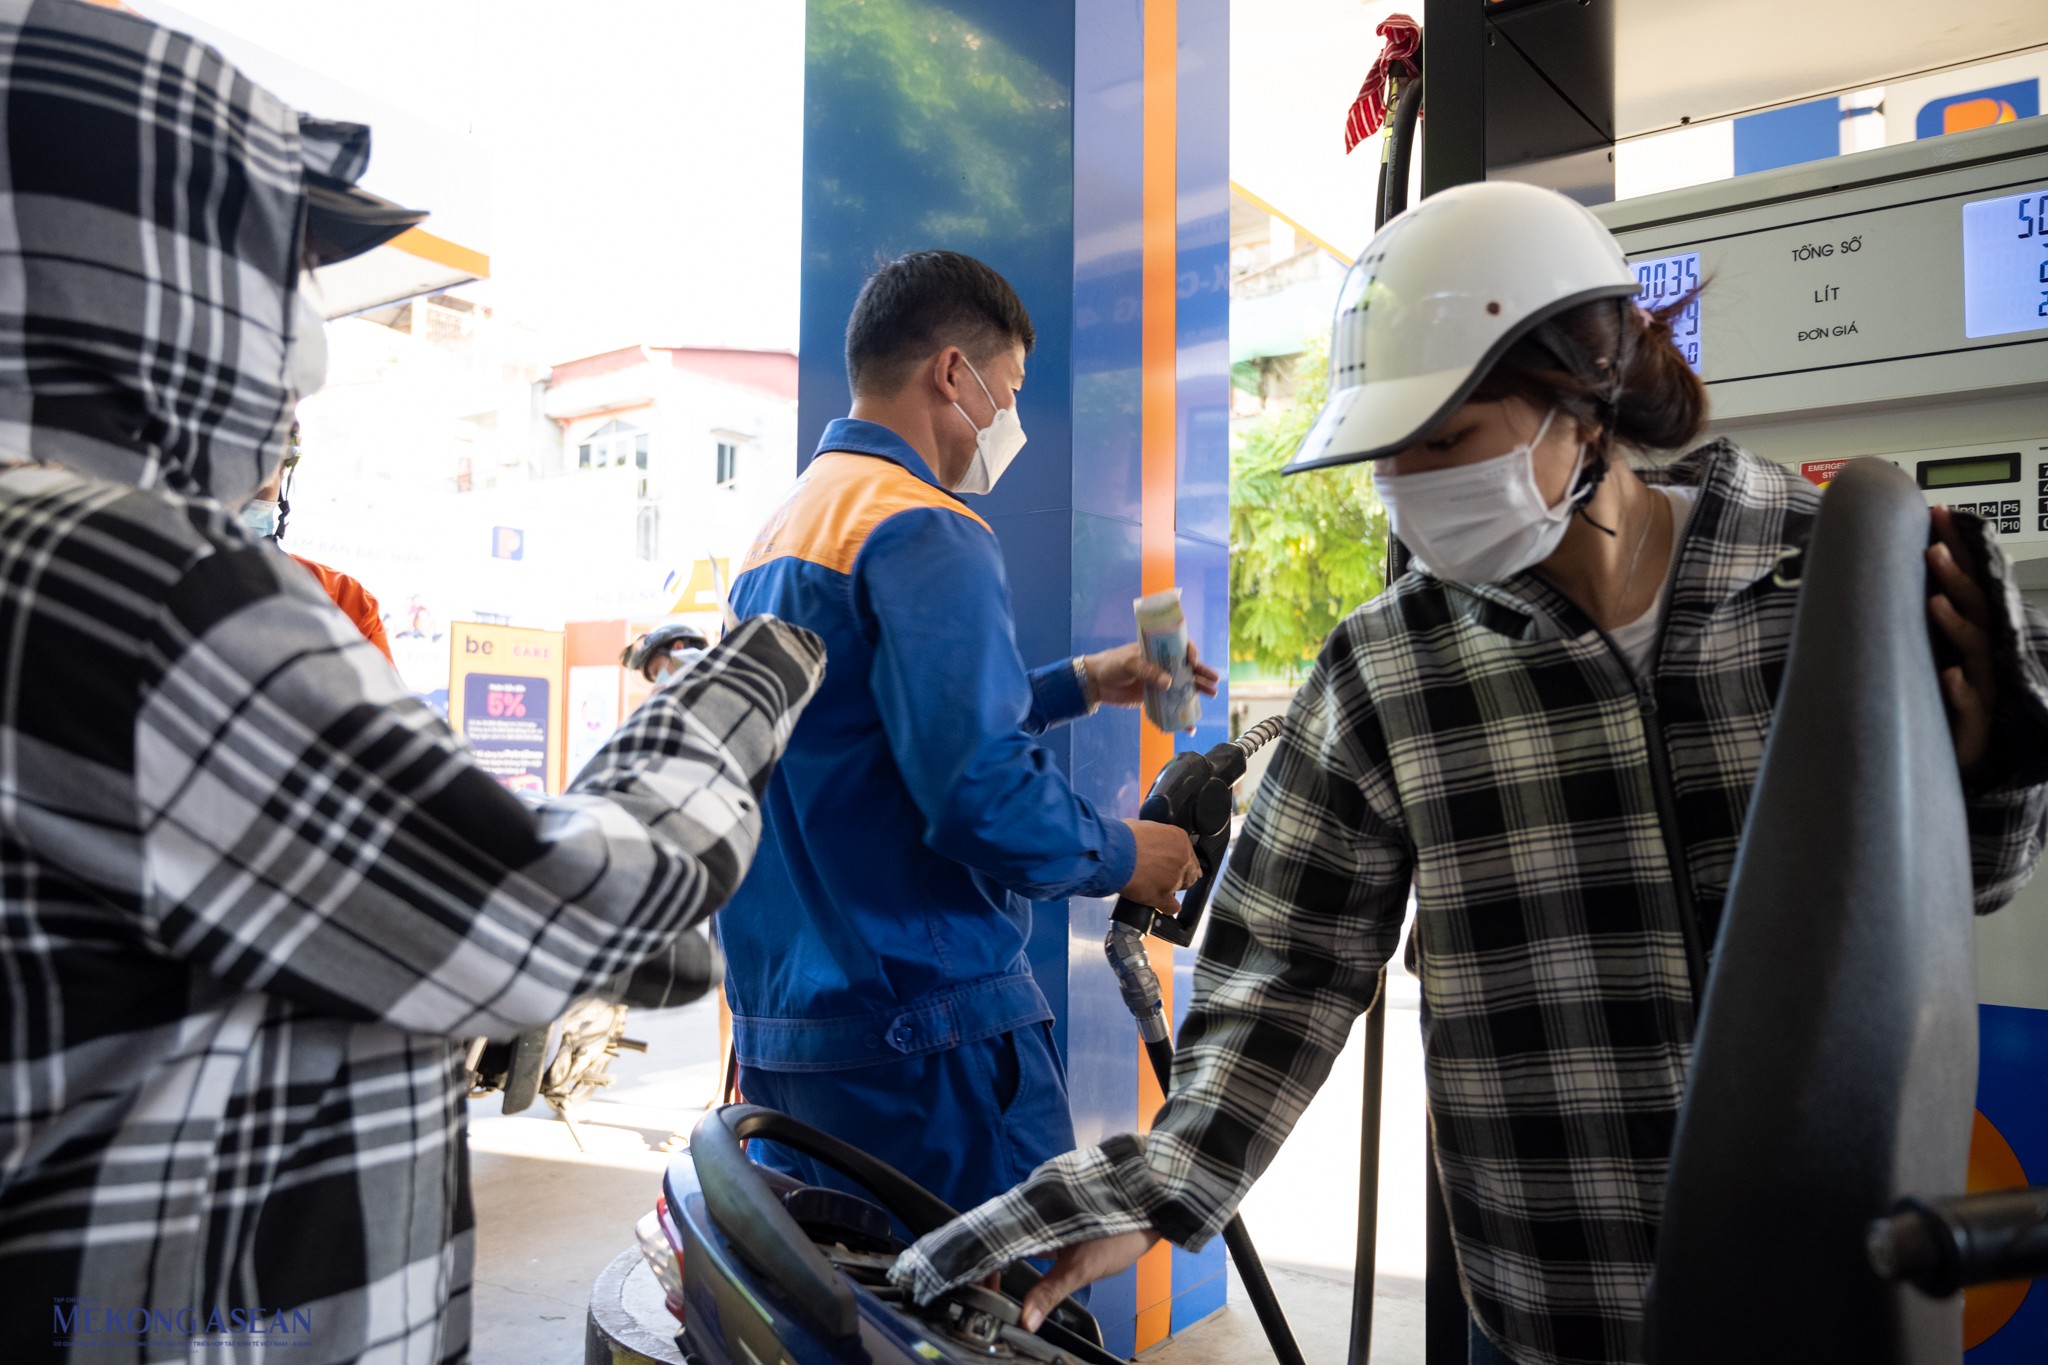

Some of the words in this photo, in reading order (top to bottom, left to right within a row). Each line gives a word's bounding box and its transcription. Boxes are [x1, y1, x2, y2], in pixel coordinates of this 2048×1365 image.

[1792, 243, 1834, 262] TỔNG
[1840, 235, 1862, 254] SỐ
[1814, 284, 1840, 304] LÍT
[1797, 327, 1829, 342] ĐƠN
[1832, 320, 1859, 337] GIÁ
[1981, 504, 1997, 515] P4
[2002, 503, 2019, 514] P5
[2001, 520, 2019, 531] P10
[487, 691, 527, 718] 5%
